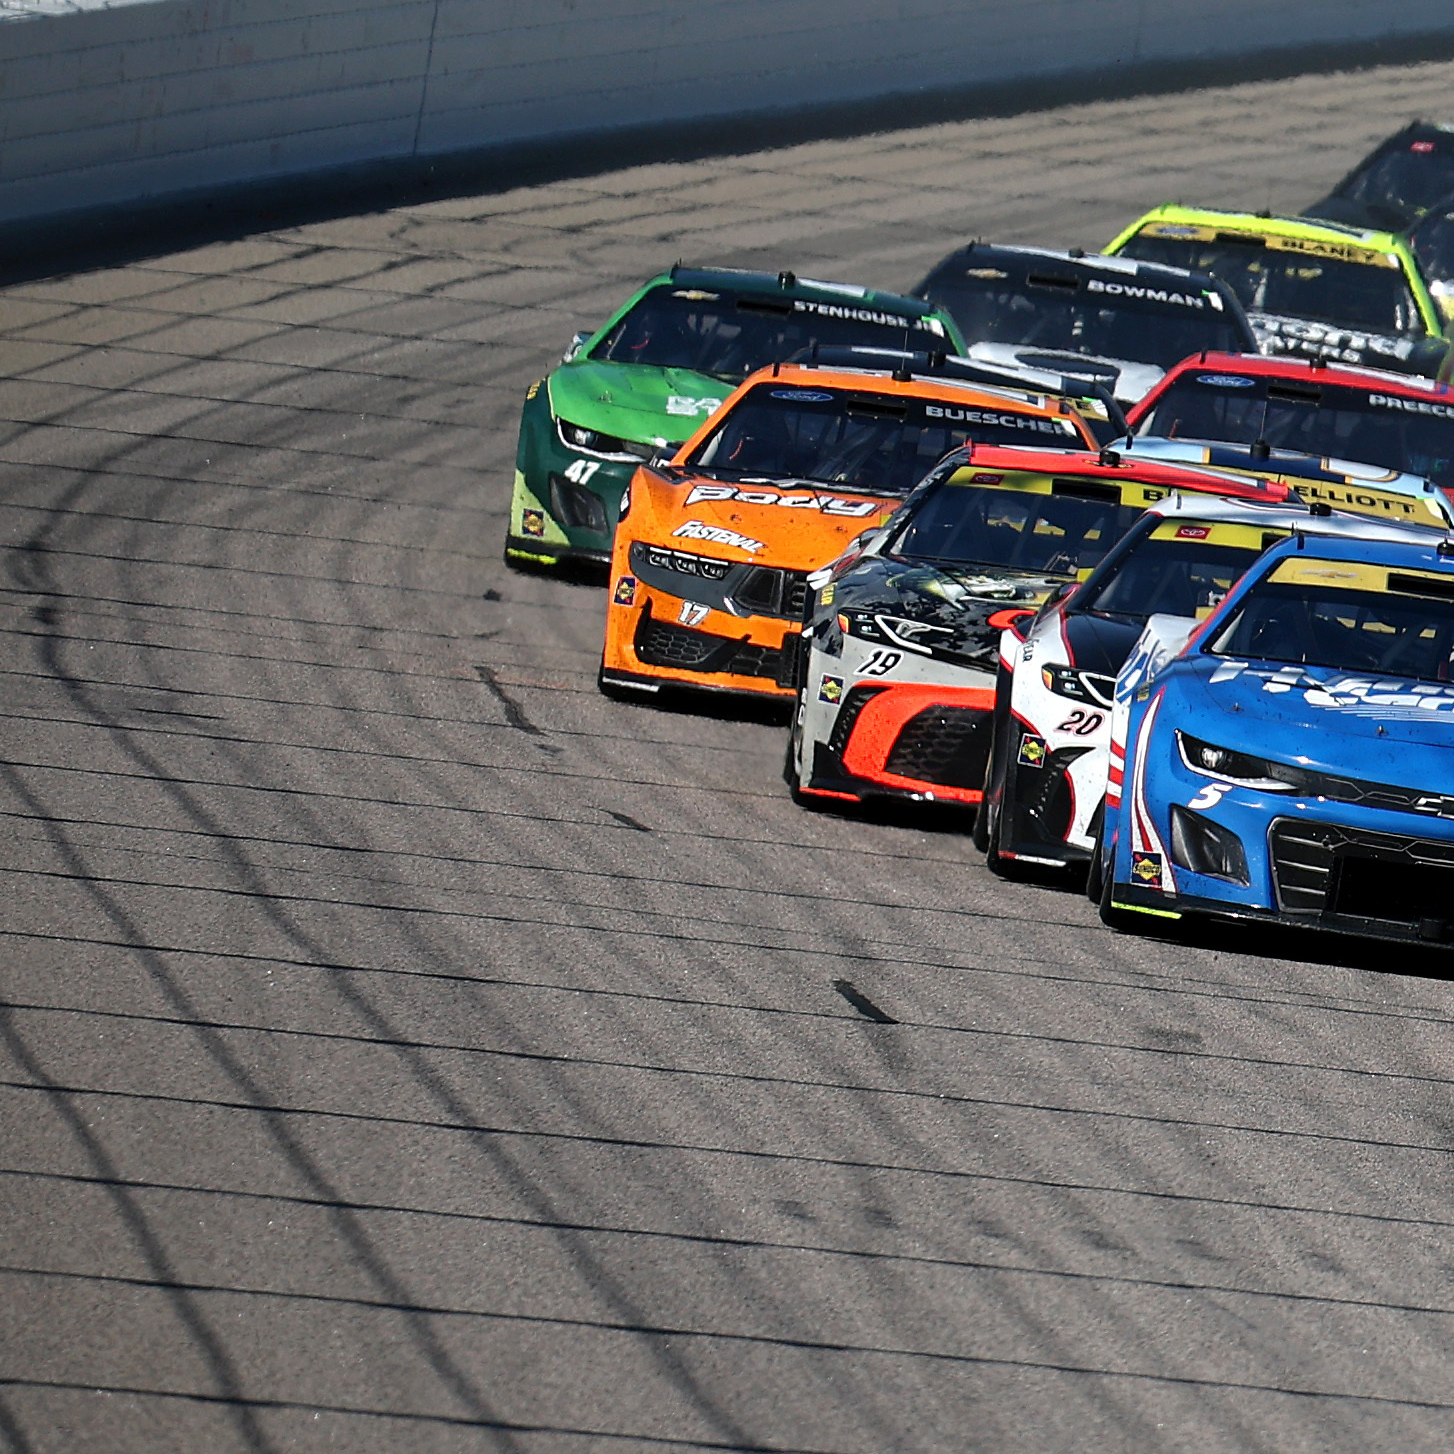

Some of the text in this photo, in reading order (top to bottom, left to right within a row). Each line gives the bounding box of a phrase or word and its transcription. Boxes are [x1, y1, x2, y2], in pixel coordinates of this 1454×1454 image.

[1087, 279, 1204, 309] BOWMAN
[794, 300, 909, 328] STENHOUSE
[564, 458, 602, 485] 47
[1293, 484, 1414, 514] ELLIOTT
[679, 601, 710, 626] 17
[854, 648, 904, 676] 19
[1057, 709, 1105, 736] 20
[1188, 783, 1233, 810] 5
[1132, 864, 1161, 876] SUNOCO
